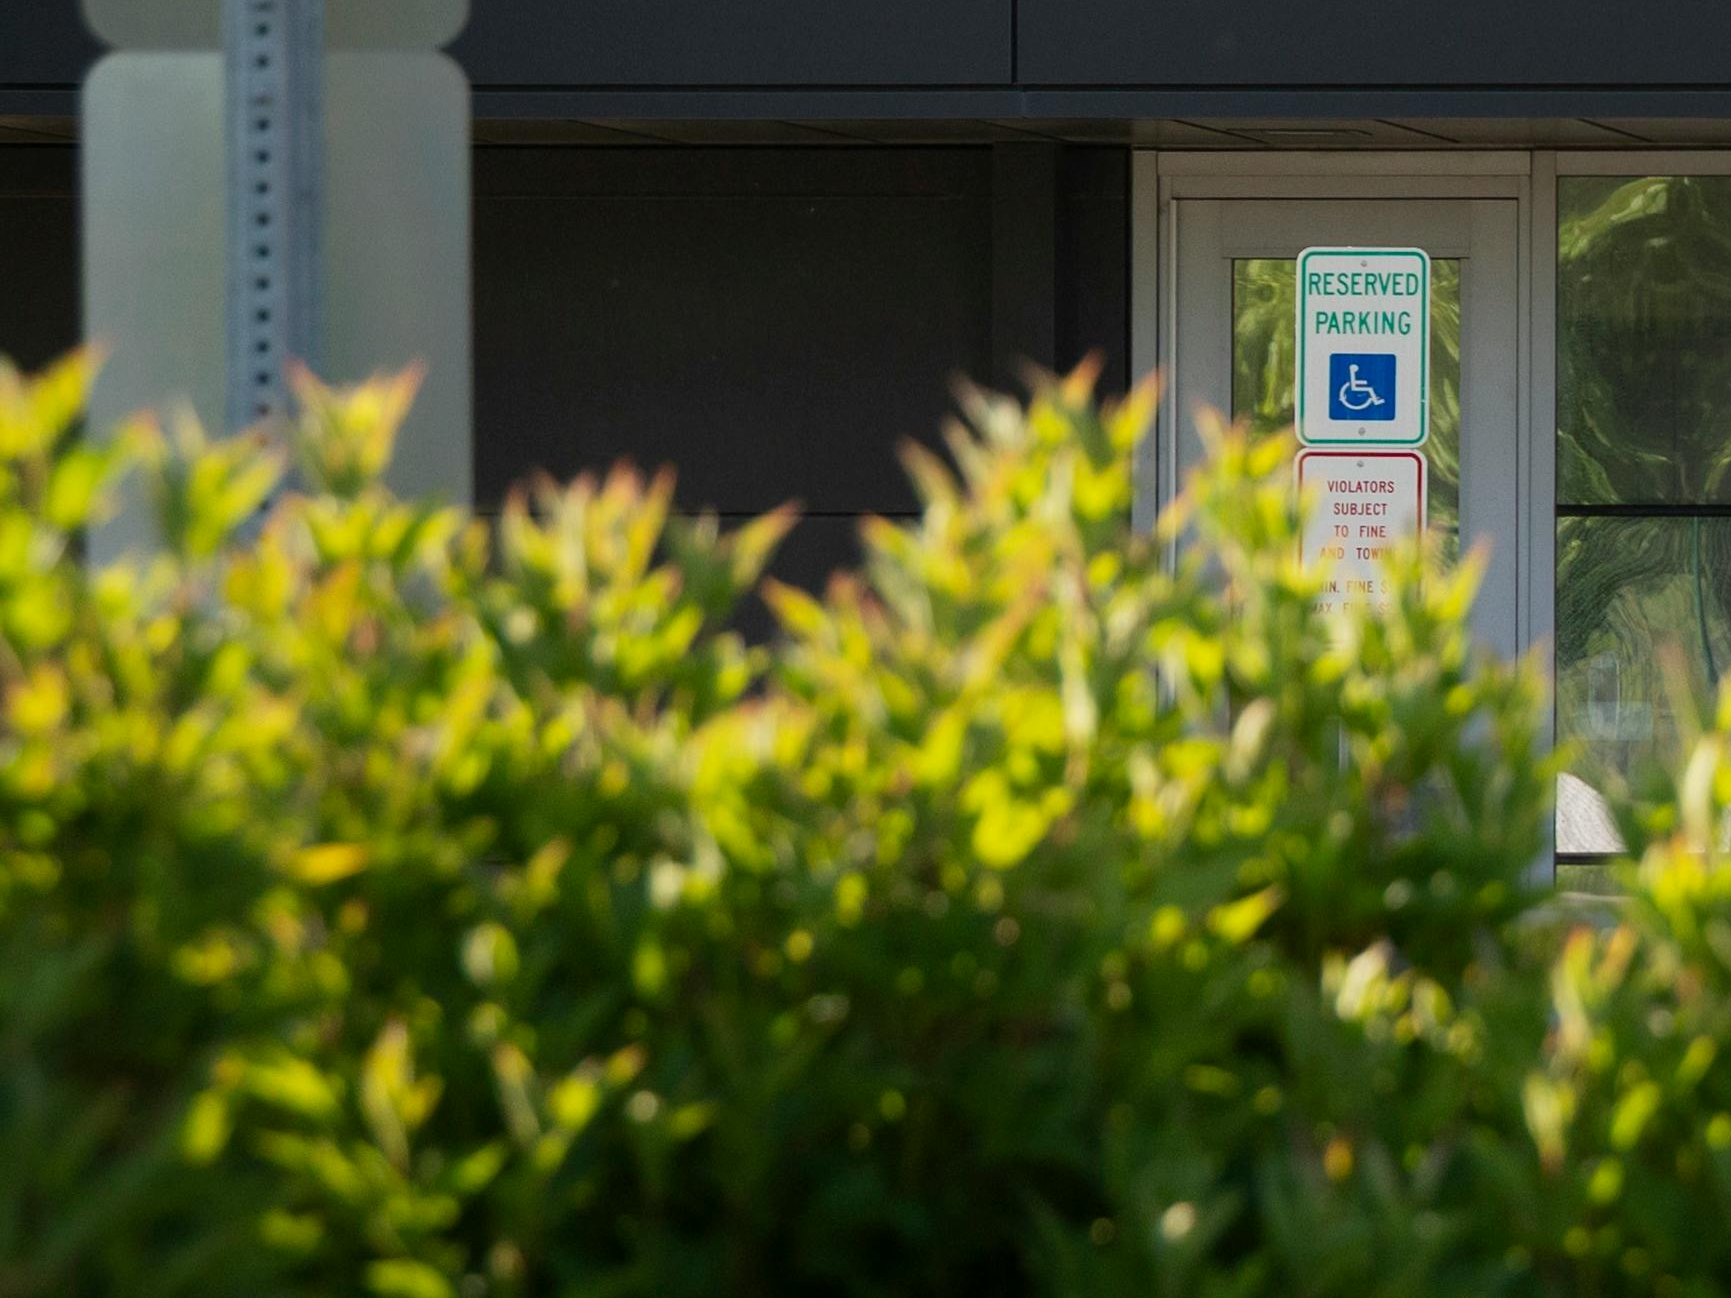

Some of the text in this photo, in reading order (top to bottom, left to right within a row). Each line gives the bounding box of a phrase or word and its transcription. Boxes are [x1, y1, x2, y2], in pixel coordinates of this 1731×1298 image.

[1308, 273, 1418, 295] RESERVED
[1316, 311, 1411, 335] PARKING
[1328, 481, 1394, 493] VIOLATORS
[1333, 503, 1388, 516] SUBJECT
[1334, 525, 1387, 538] TO FINE
[1320, 547, 1345, 560] AND
